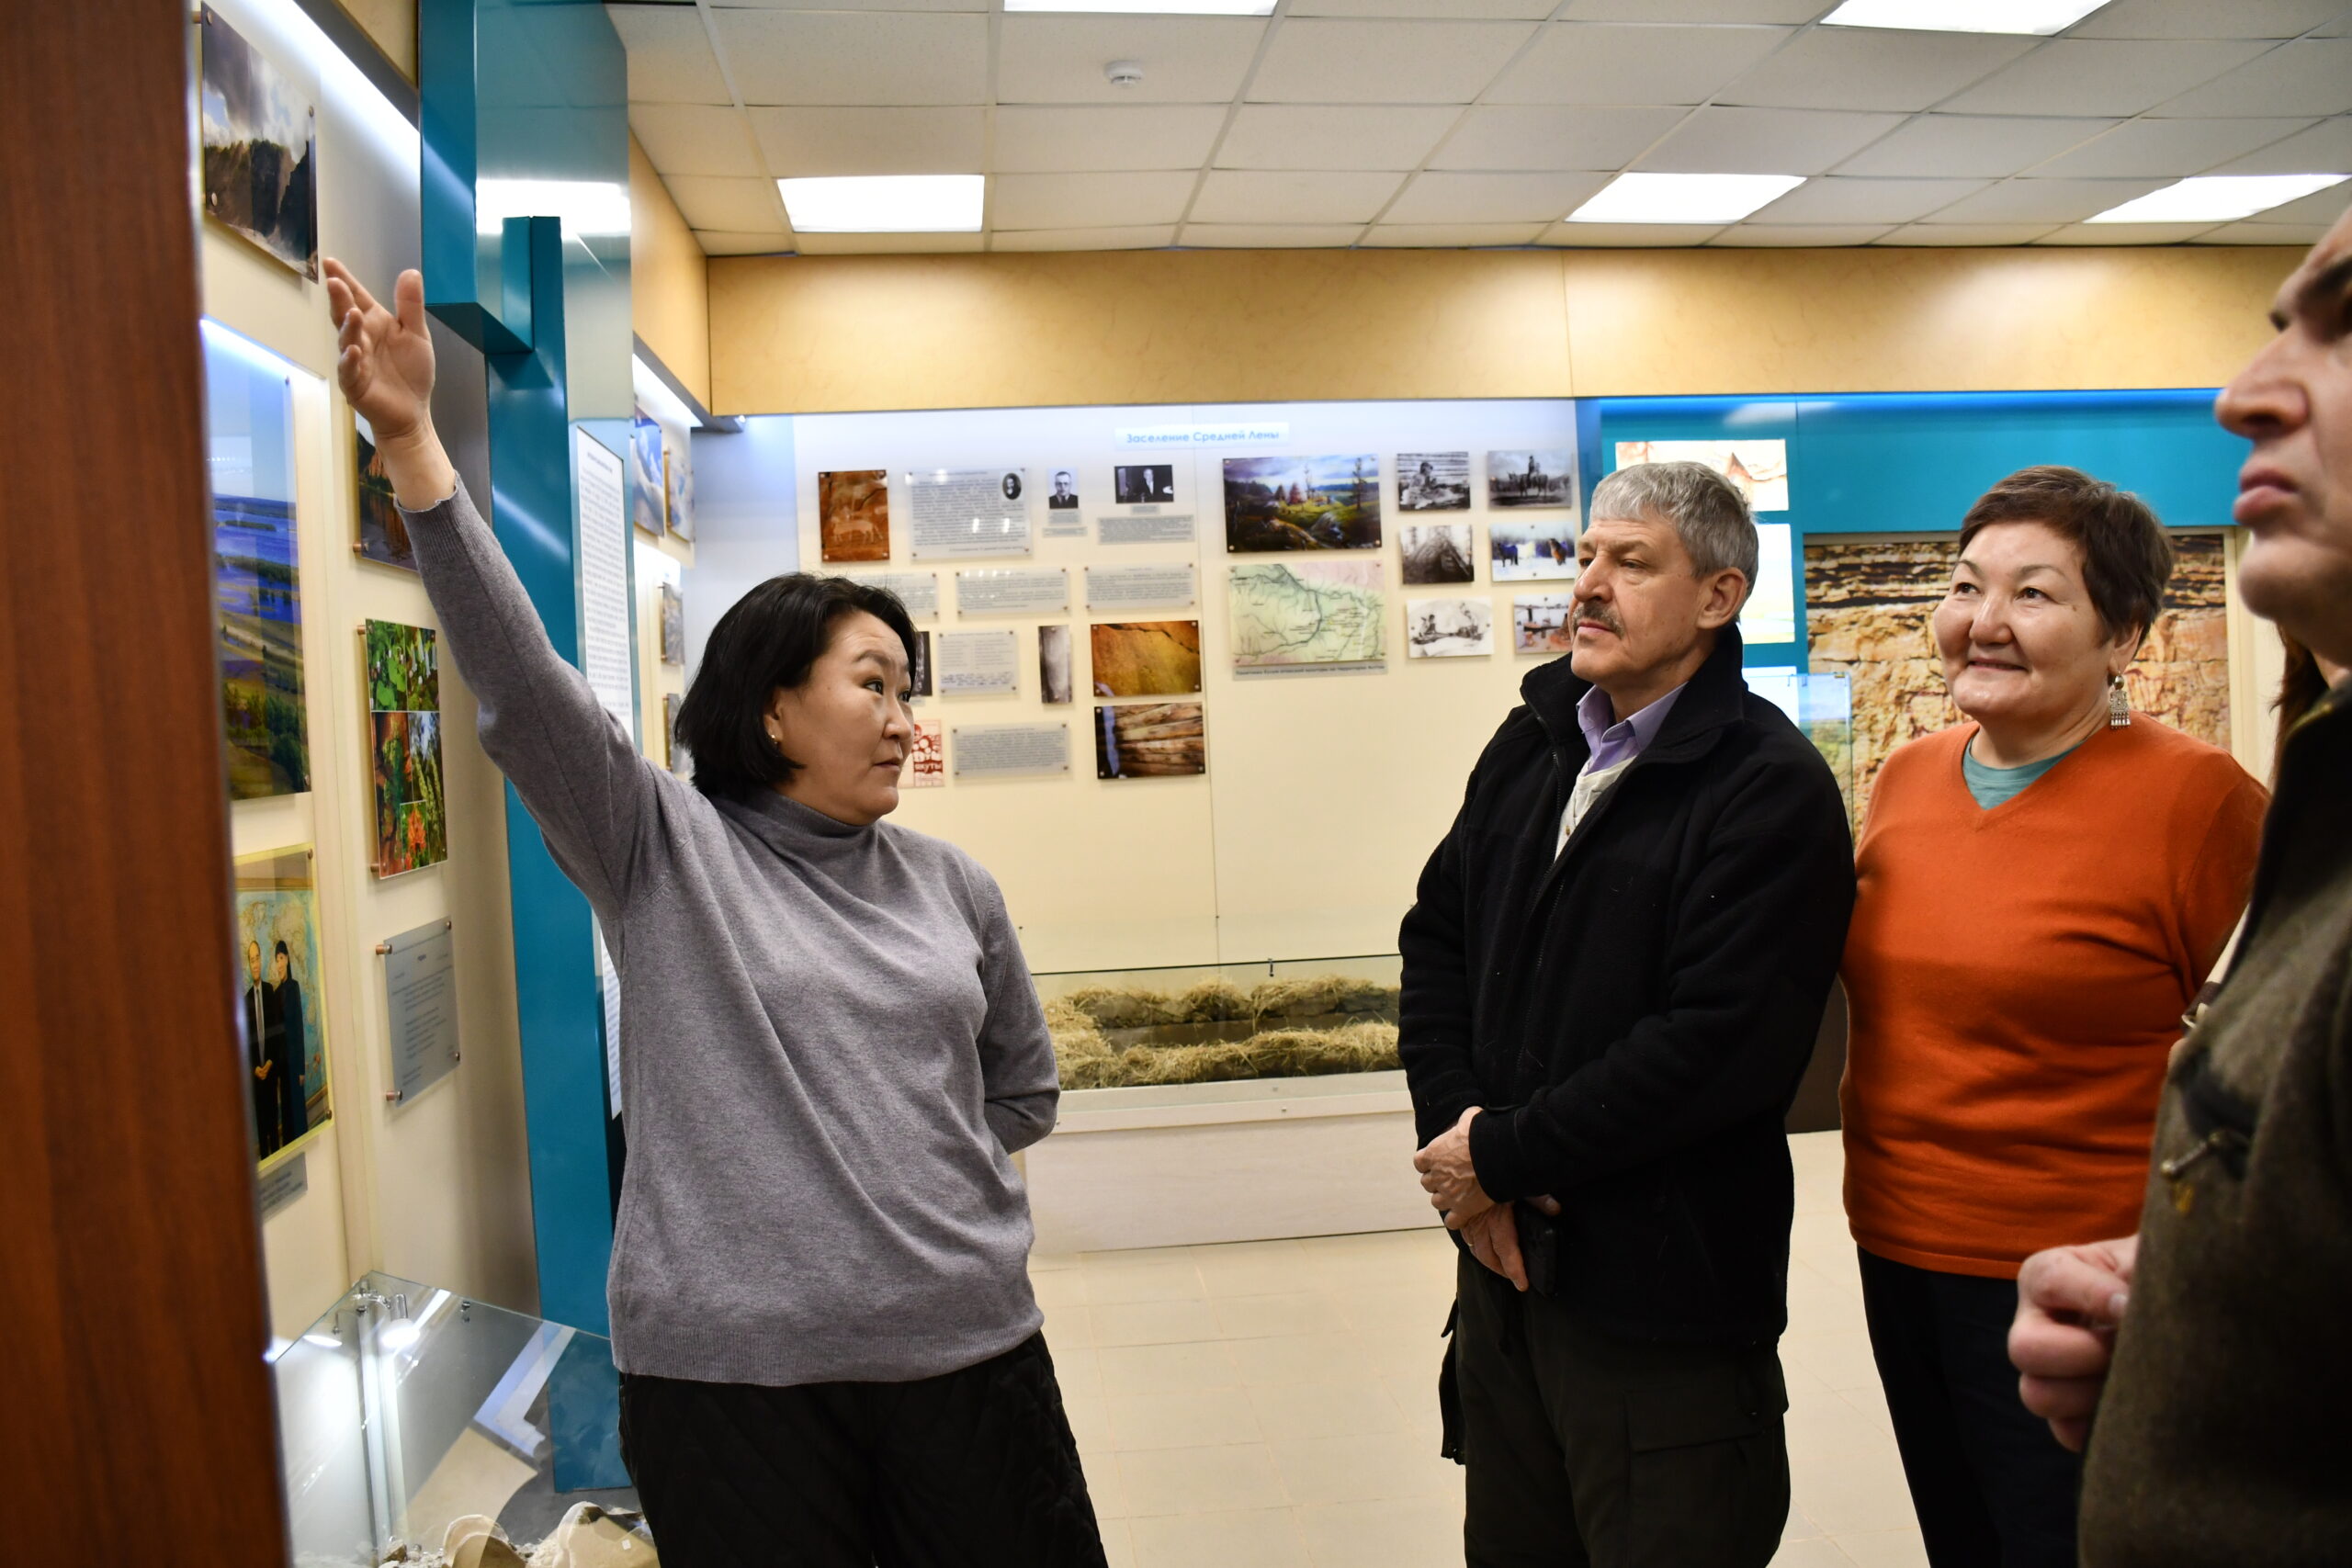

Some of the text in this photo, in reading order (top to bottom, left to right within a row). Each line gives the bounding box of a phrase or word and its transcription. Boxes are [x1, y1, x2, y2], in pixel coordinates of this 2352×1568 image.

[1126, 431, 1280, 444] Заселение Средней Лены
